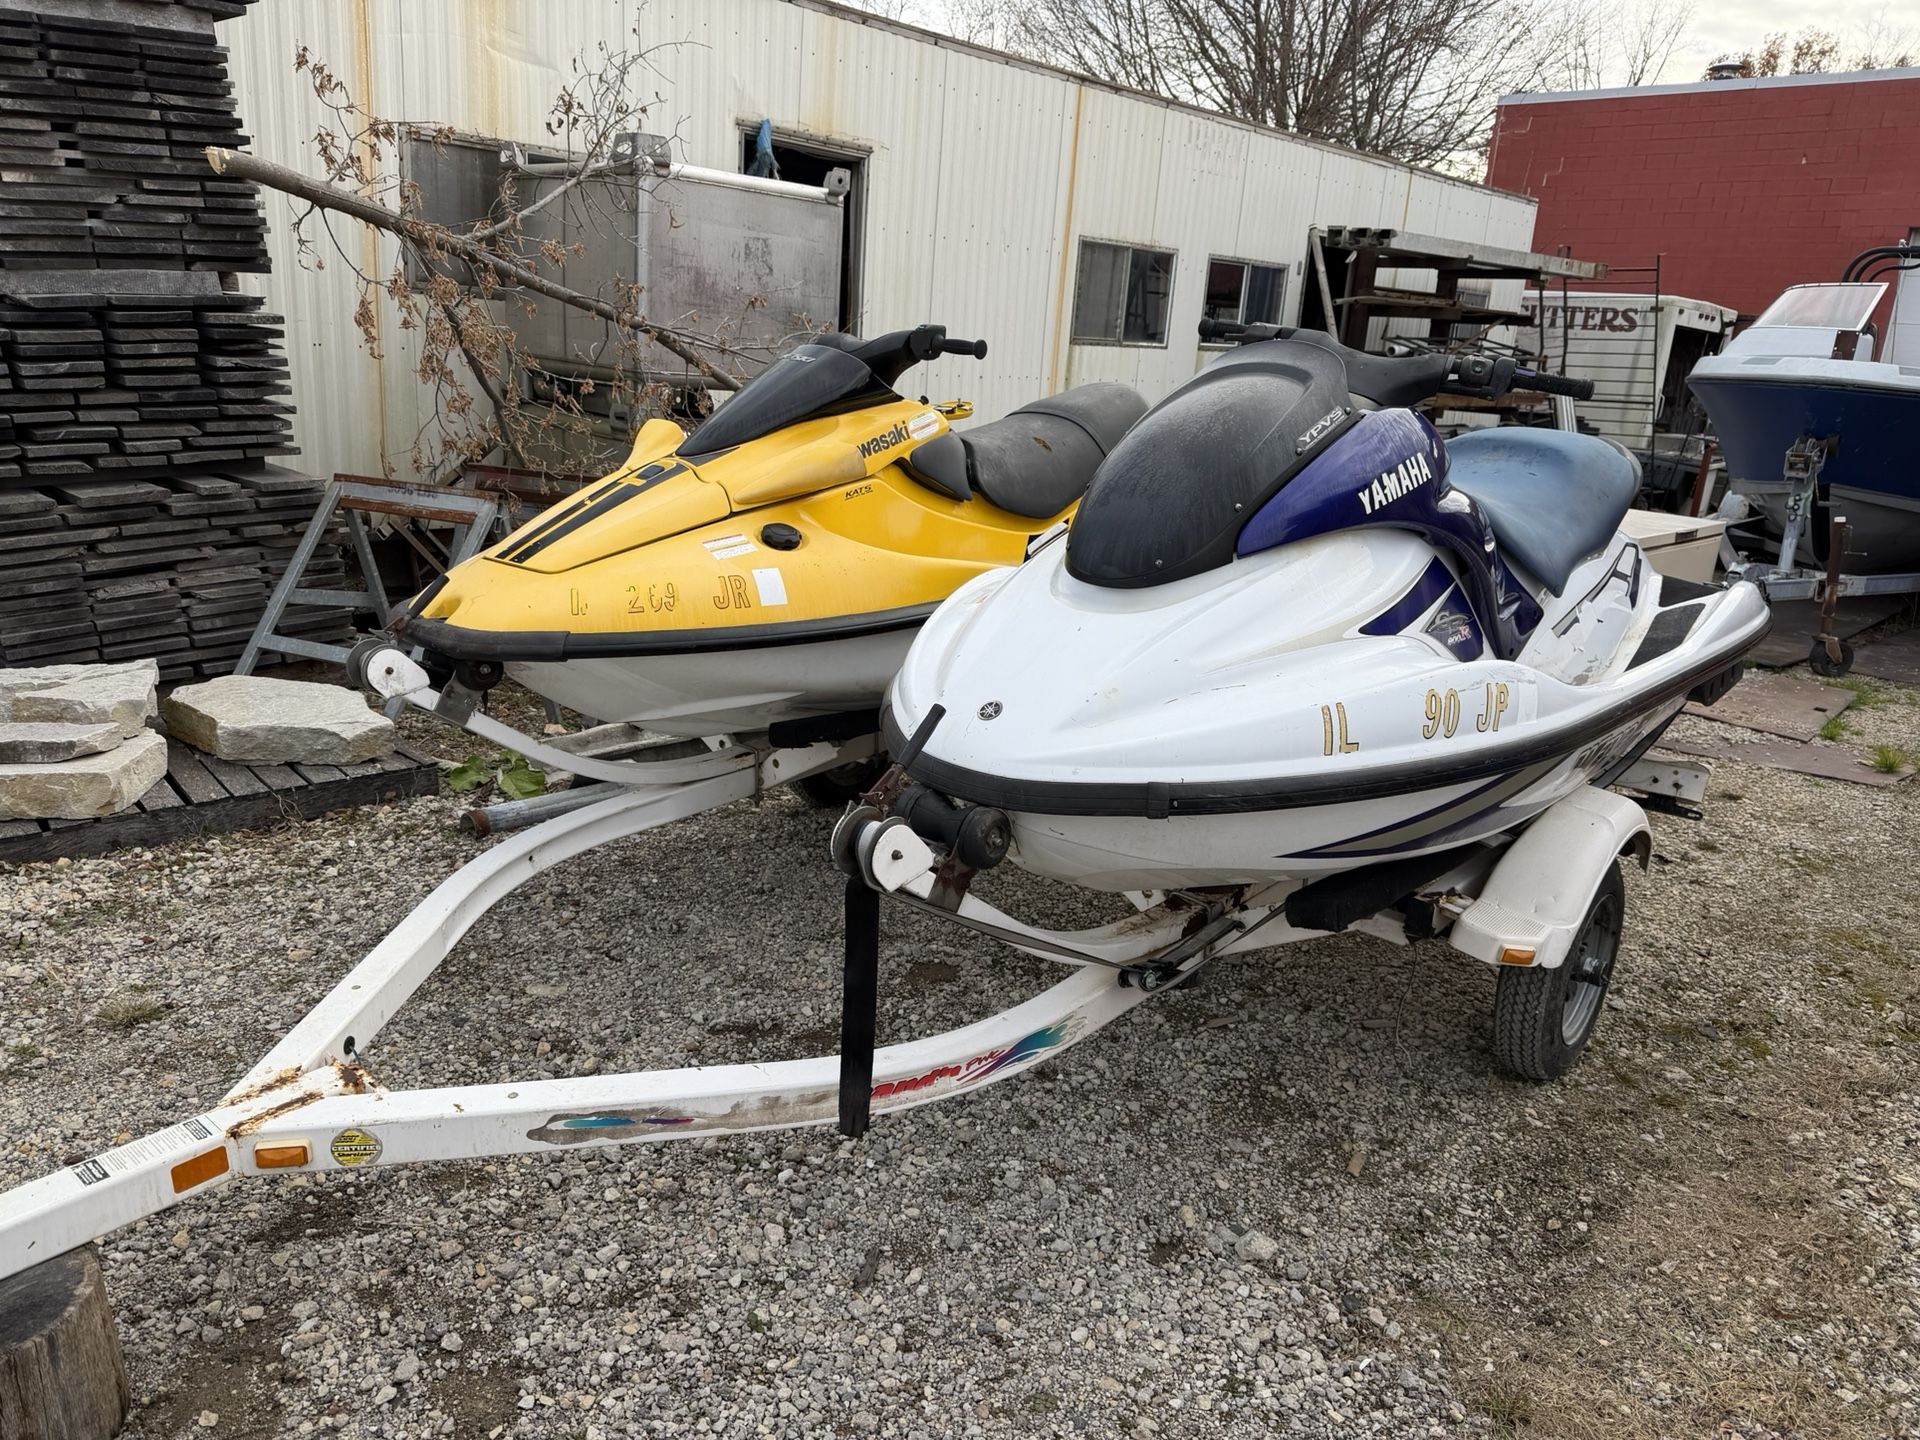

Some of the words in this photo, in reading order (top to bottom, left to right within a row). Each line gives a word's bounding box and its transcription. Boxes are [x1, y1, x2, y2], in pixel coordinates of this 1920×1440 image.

[1521, 305, 1639, 333] UTTERS
[856, 420, 911, 459] wasaki
[1298, 406, 1343, 443] YPVS
[1358, 452, 1432, 515] YAMAHA
[713, 575, 752, 609] JR
[1321, 702, 1360, 756] IL
[1422, 687, 1461, 739] 90
[1476, 682, 1510, 732] JP
